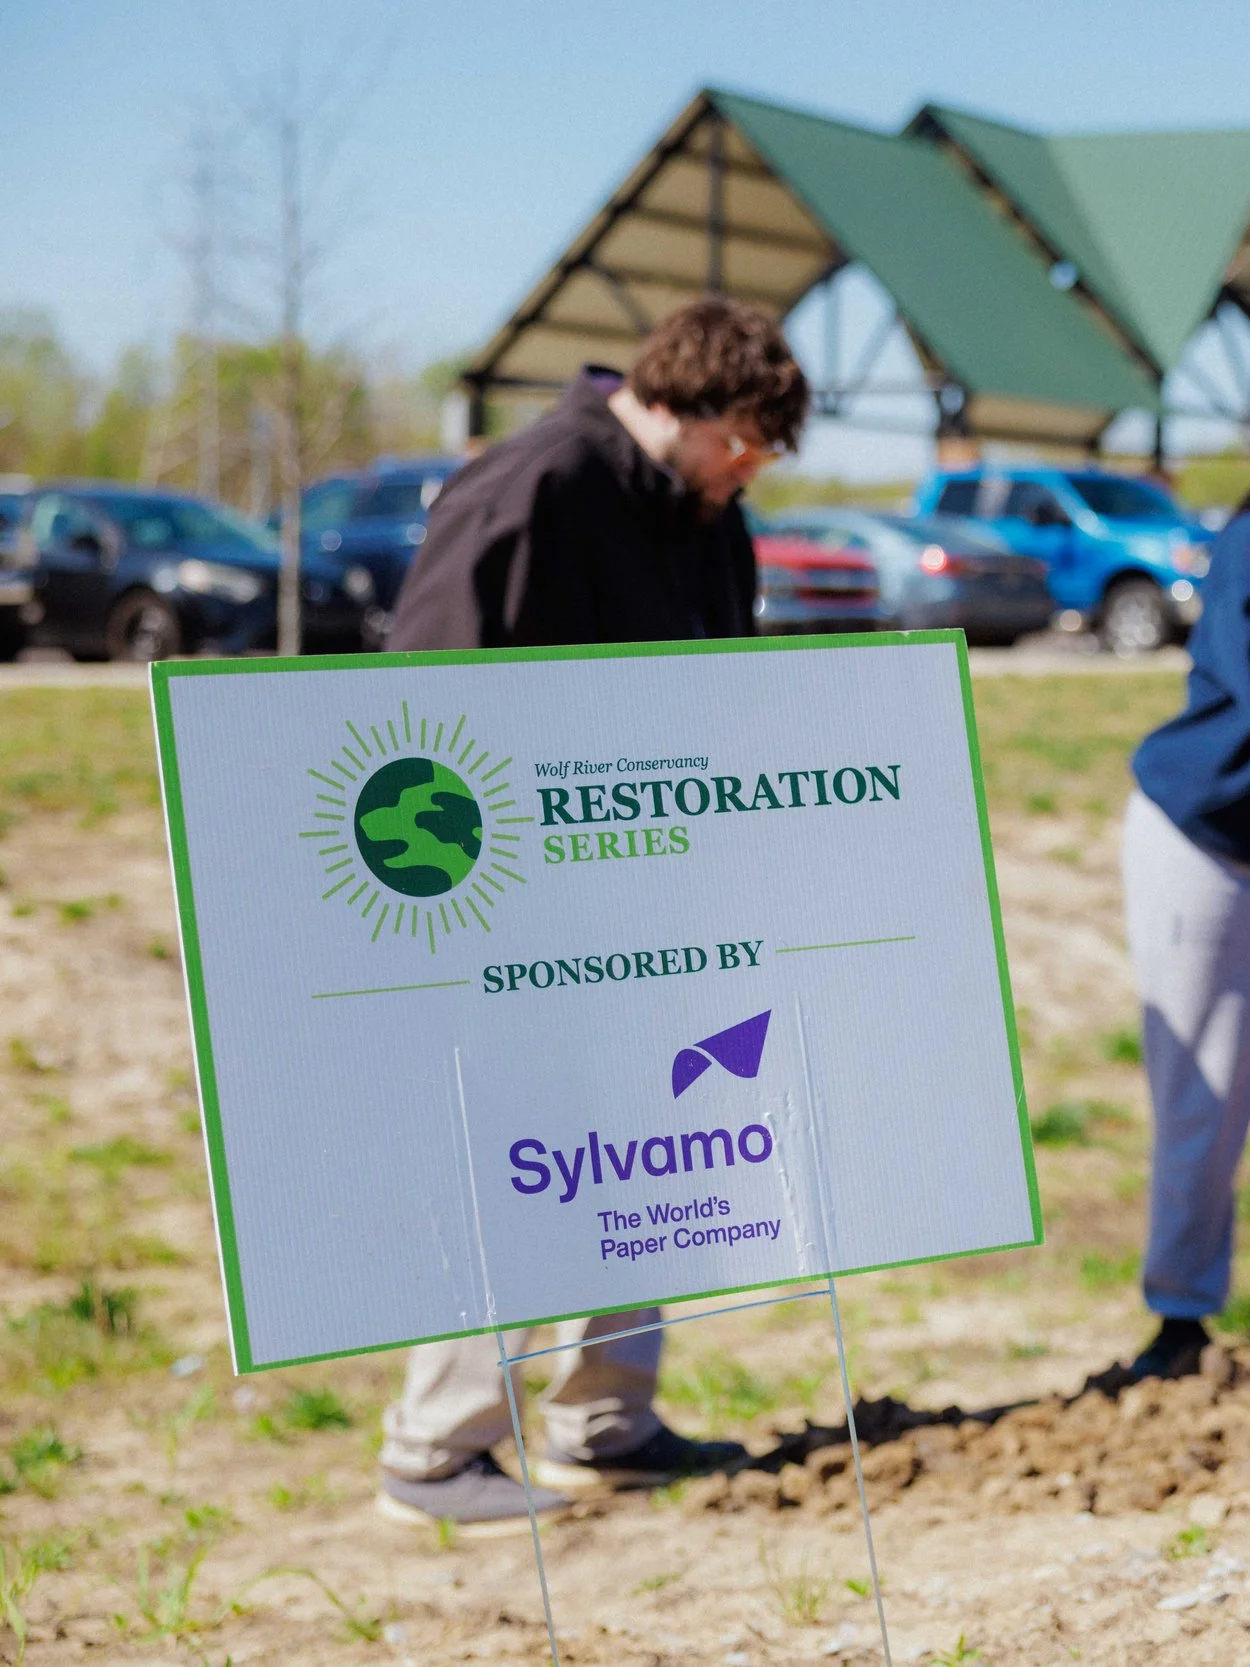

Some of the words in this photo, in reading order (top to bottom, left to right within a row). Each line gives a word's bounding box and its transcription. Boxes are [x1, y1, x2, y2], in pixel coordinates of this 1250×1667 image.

[534, 761, 571, 779] Wolf
[573, 760, 613, 775] River
[616, 755, 709, 773] Conservancy
[537, 764, 902, 826] RESTORATION
[543, 825, 690, 865] SERIES
[483, 946, 708, 994] SPONSORED
[715, 939, 764, 970] BY
[509, 1123, 773, 1204] Sylvamo
[598, 1210, 642, 1233] The
[600, 1235, 668, 1261] Paper
[673, 1219, 781, 1248] Company
